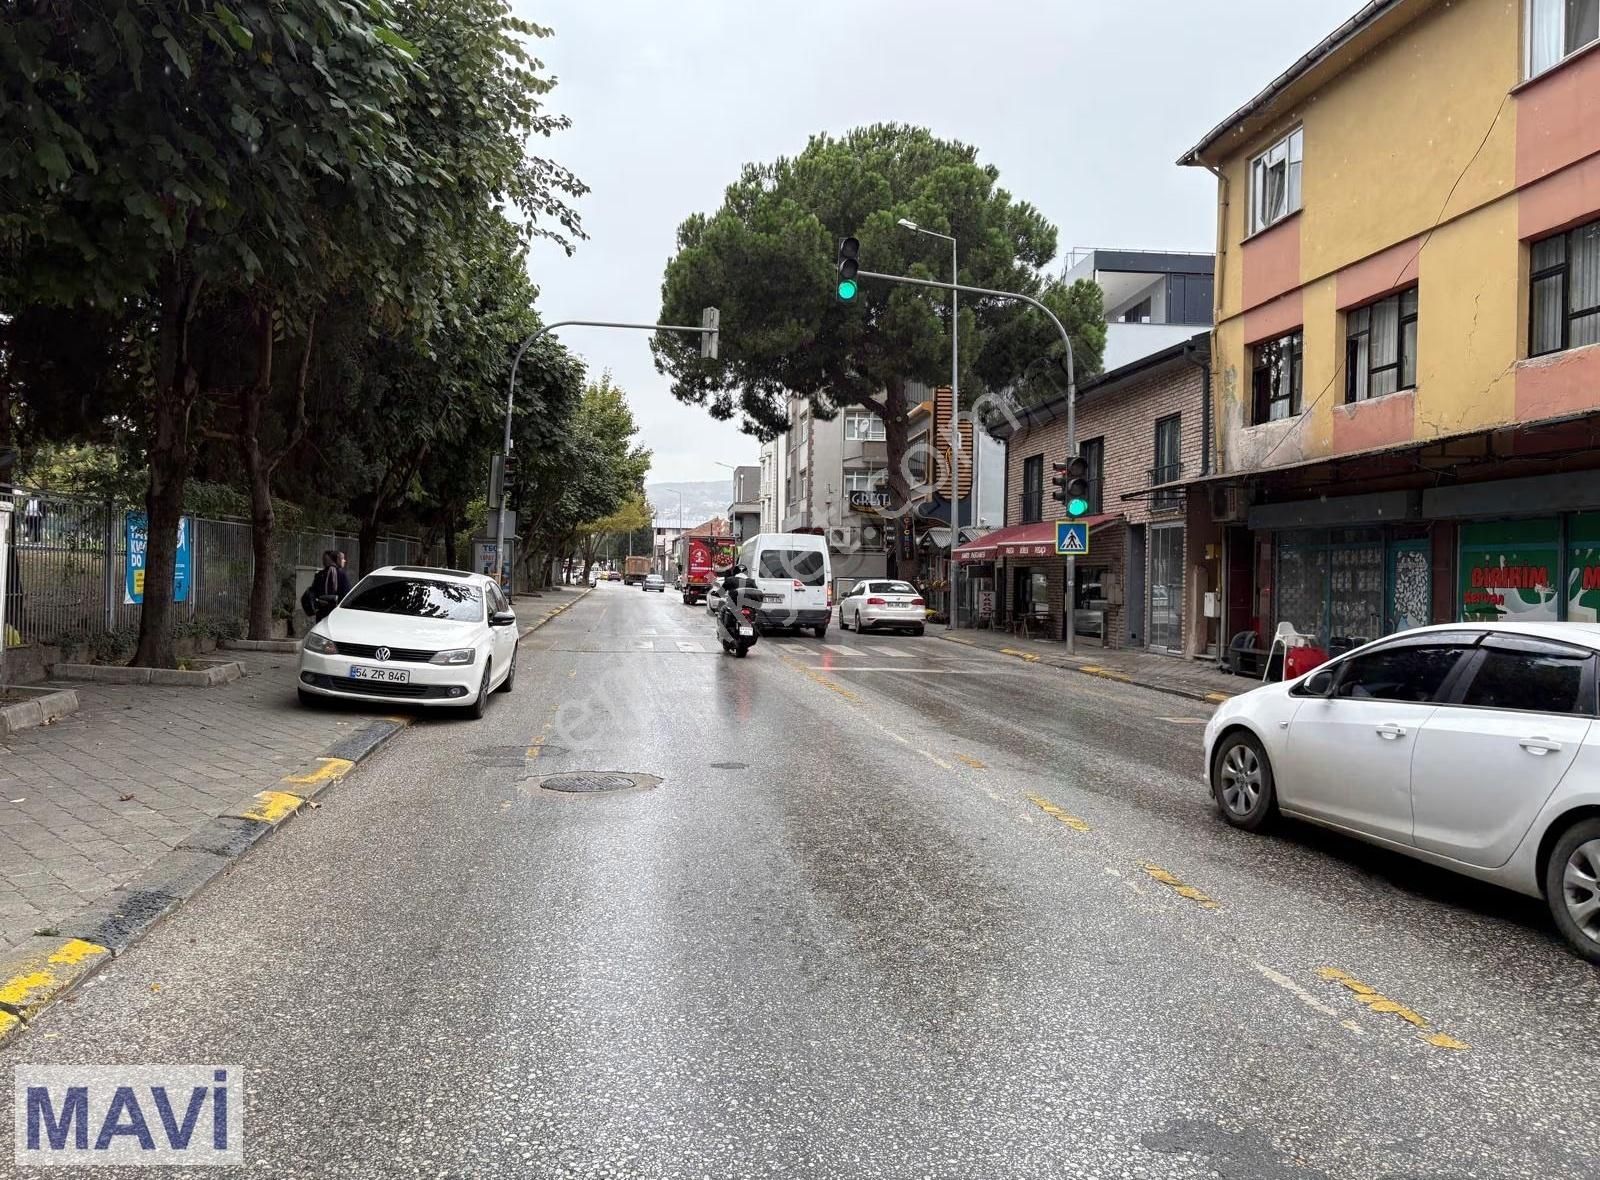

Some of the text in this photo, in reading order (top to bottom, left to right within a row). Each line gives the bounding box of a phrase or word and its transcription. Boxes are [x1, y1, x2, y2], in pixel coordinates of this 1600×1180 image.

[131, 554, 142, 567] DO
[356, 668, 406, 682] 54 ZR 846
